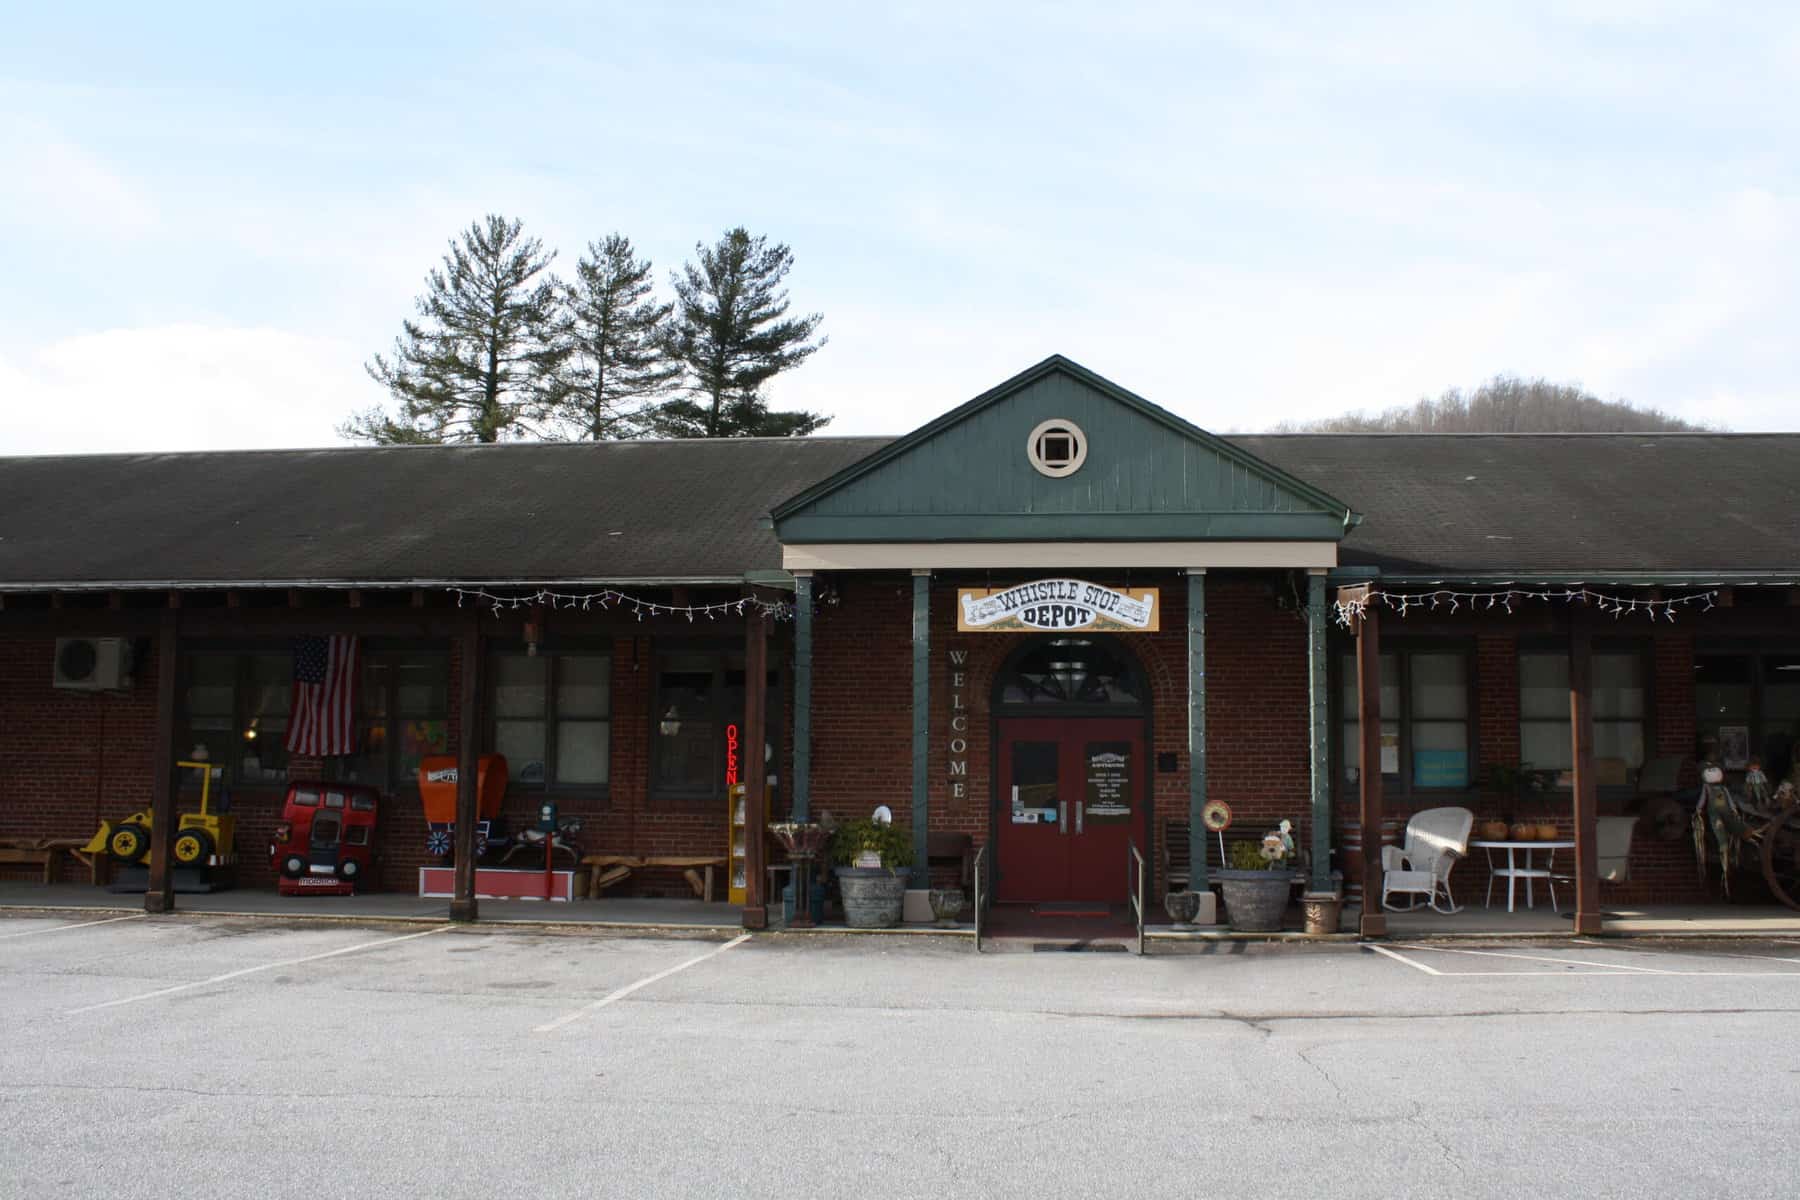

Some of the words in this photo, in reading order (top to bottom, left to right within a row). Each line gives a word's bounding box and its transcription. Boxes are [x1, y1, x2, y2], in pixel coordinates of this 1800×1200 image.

[996, 582, 1078, 611] WHISTLE
[1084, 586, 1121, 612] STOP
[1024, 604, 1091, 627] DEPOT
[950, 650, 968, 797] WELCOME
[726, 723, 738, 784] OPEN
